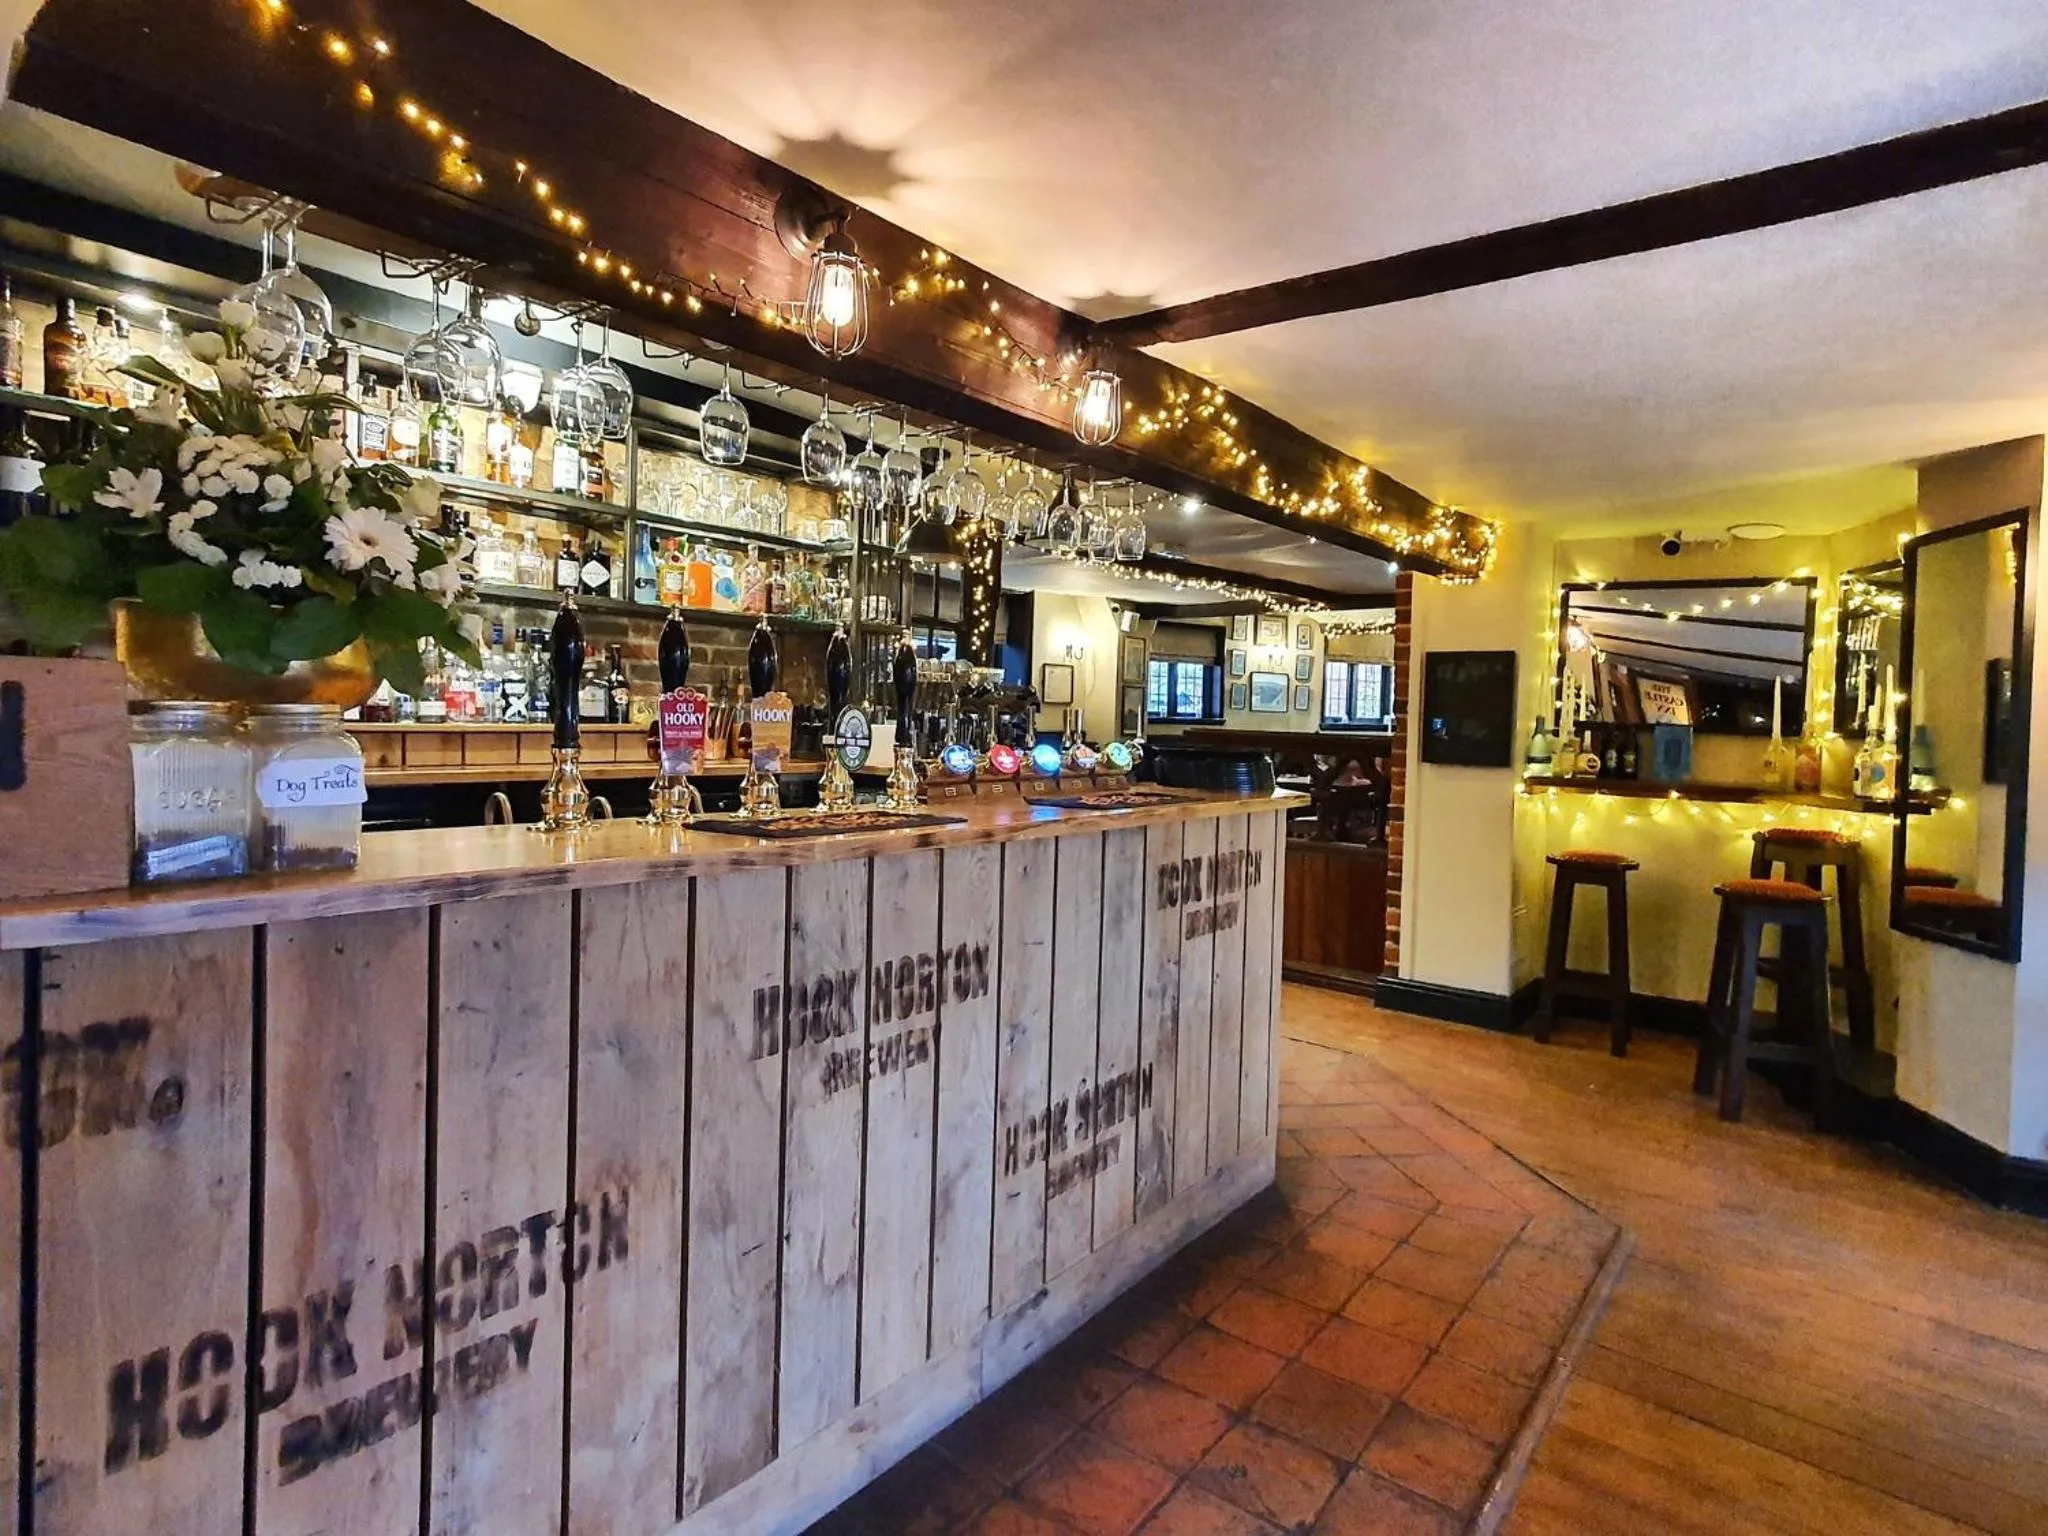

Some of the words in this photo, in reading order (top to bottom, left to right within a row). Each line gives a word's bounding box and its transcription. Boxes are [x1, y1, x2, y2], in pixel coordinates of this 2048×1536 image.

[664, 712, 705, 726] HOOKY
[676, 703, 695, 713] OLD
[754, 708, 792, 722] HOOKY
[276, 777, 307, 802] Dog
[310, 764, 360, 791] Treats
[872, 940, 990, 1026] NORTON
[383, 1185, 629, 1361] NORTON
